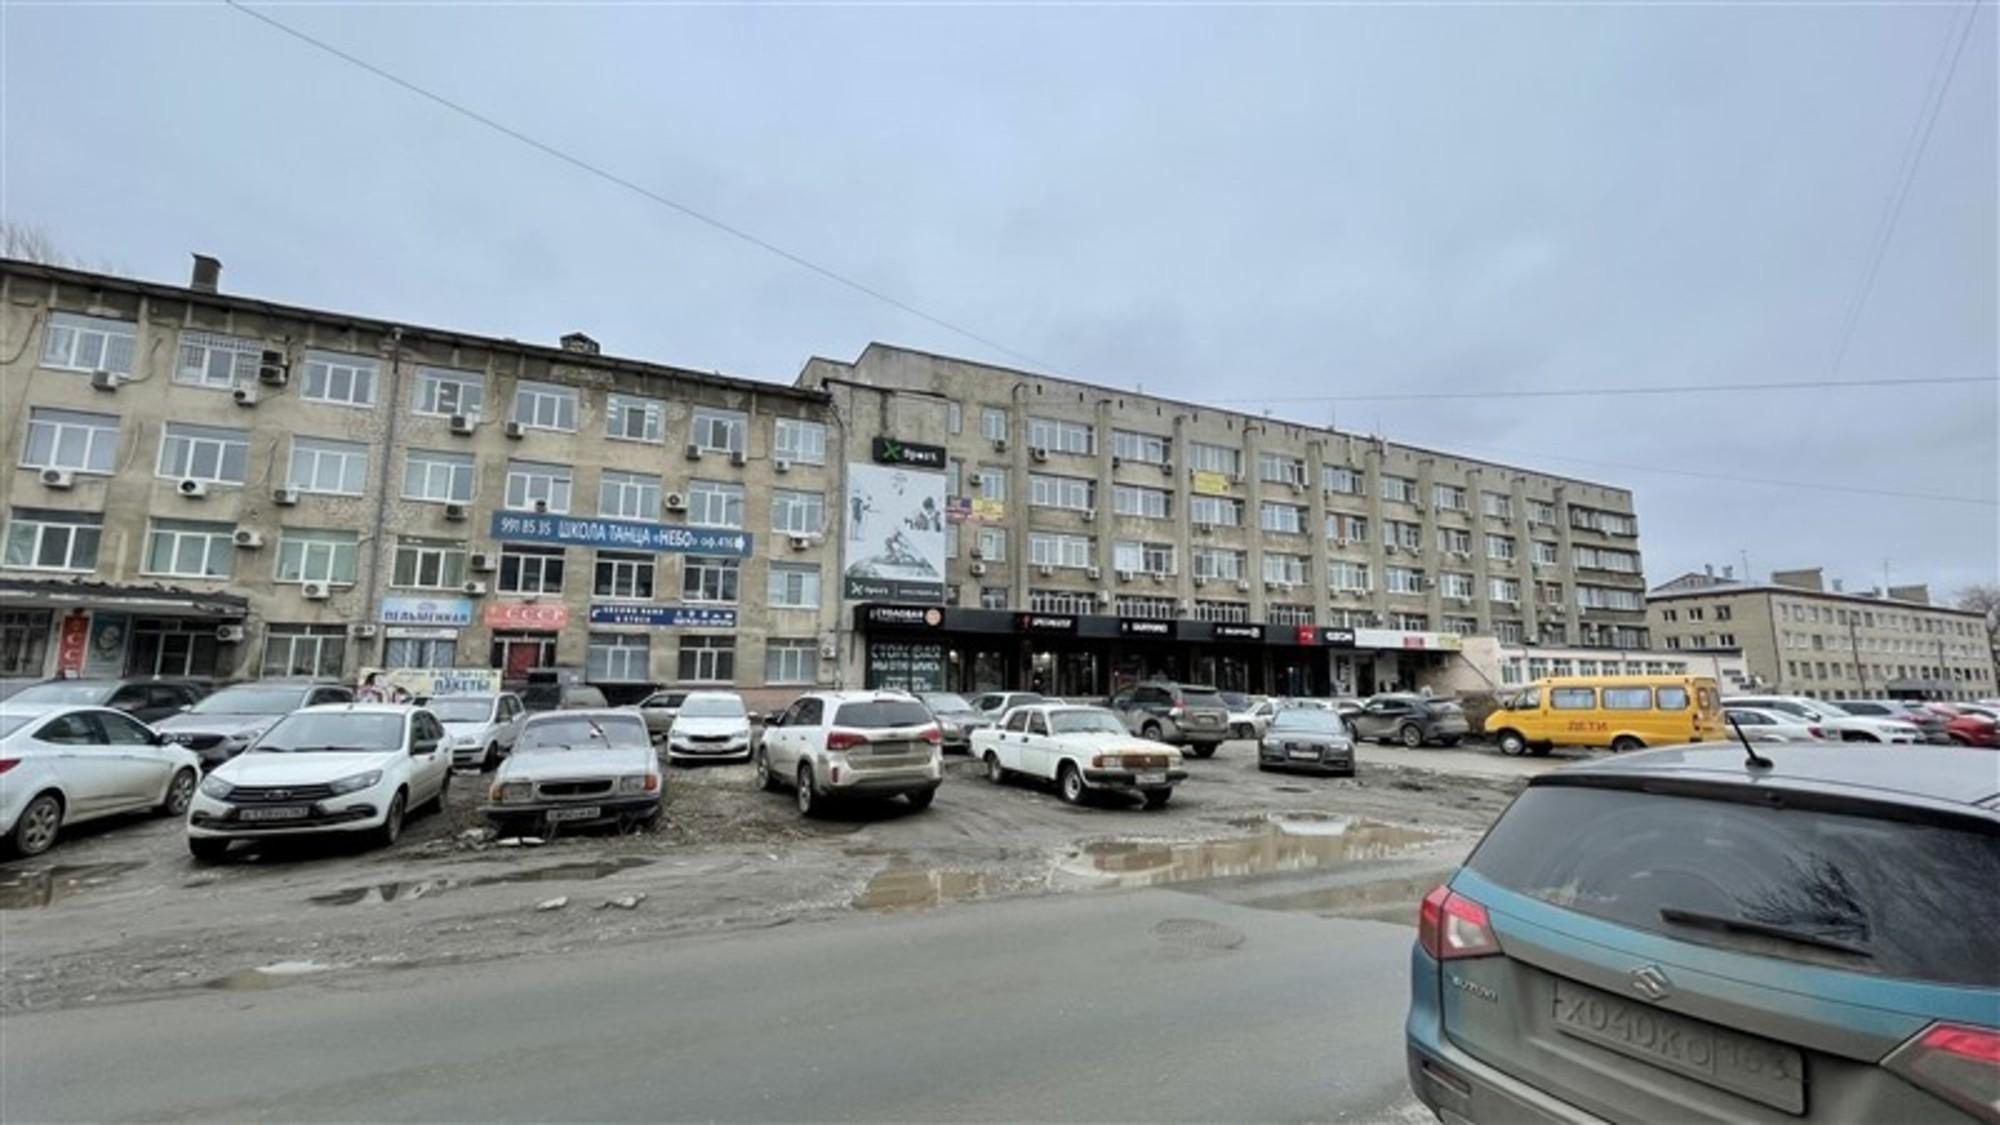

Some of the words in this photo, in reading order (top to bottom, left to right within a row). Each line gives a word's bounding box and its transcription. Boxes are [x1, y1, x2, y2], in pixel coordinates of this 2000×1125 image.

[501, 516, 520, 533] 991
[522, 518, 536, 534] 85
[537, 519, 551, 536] 35
[557, 519, 606, 542] ШКОЛА
[608, 523, 650, 547] ТАНЦА
[653, 528, 698, 548] «НЕБО»
[384, 610, 468, 622] ПЕЛЬМЕННАЯ
[1567, 721, 1609, 732] ДЕТИ
